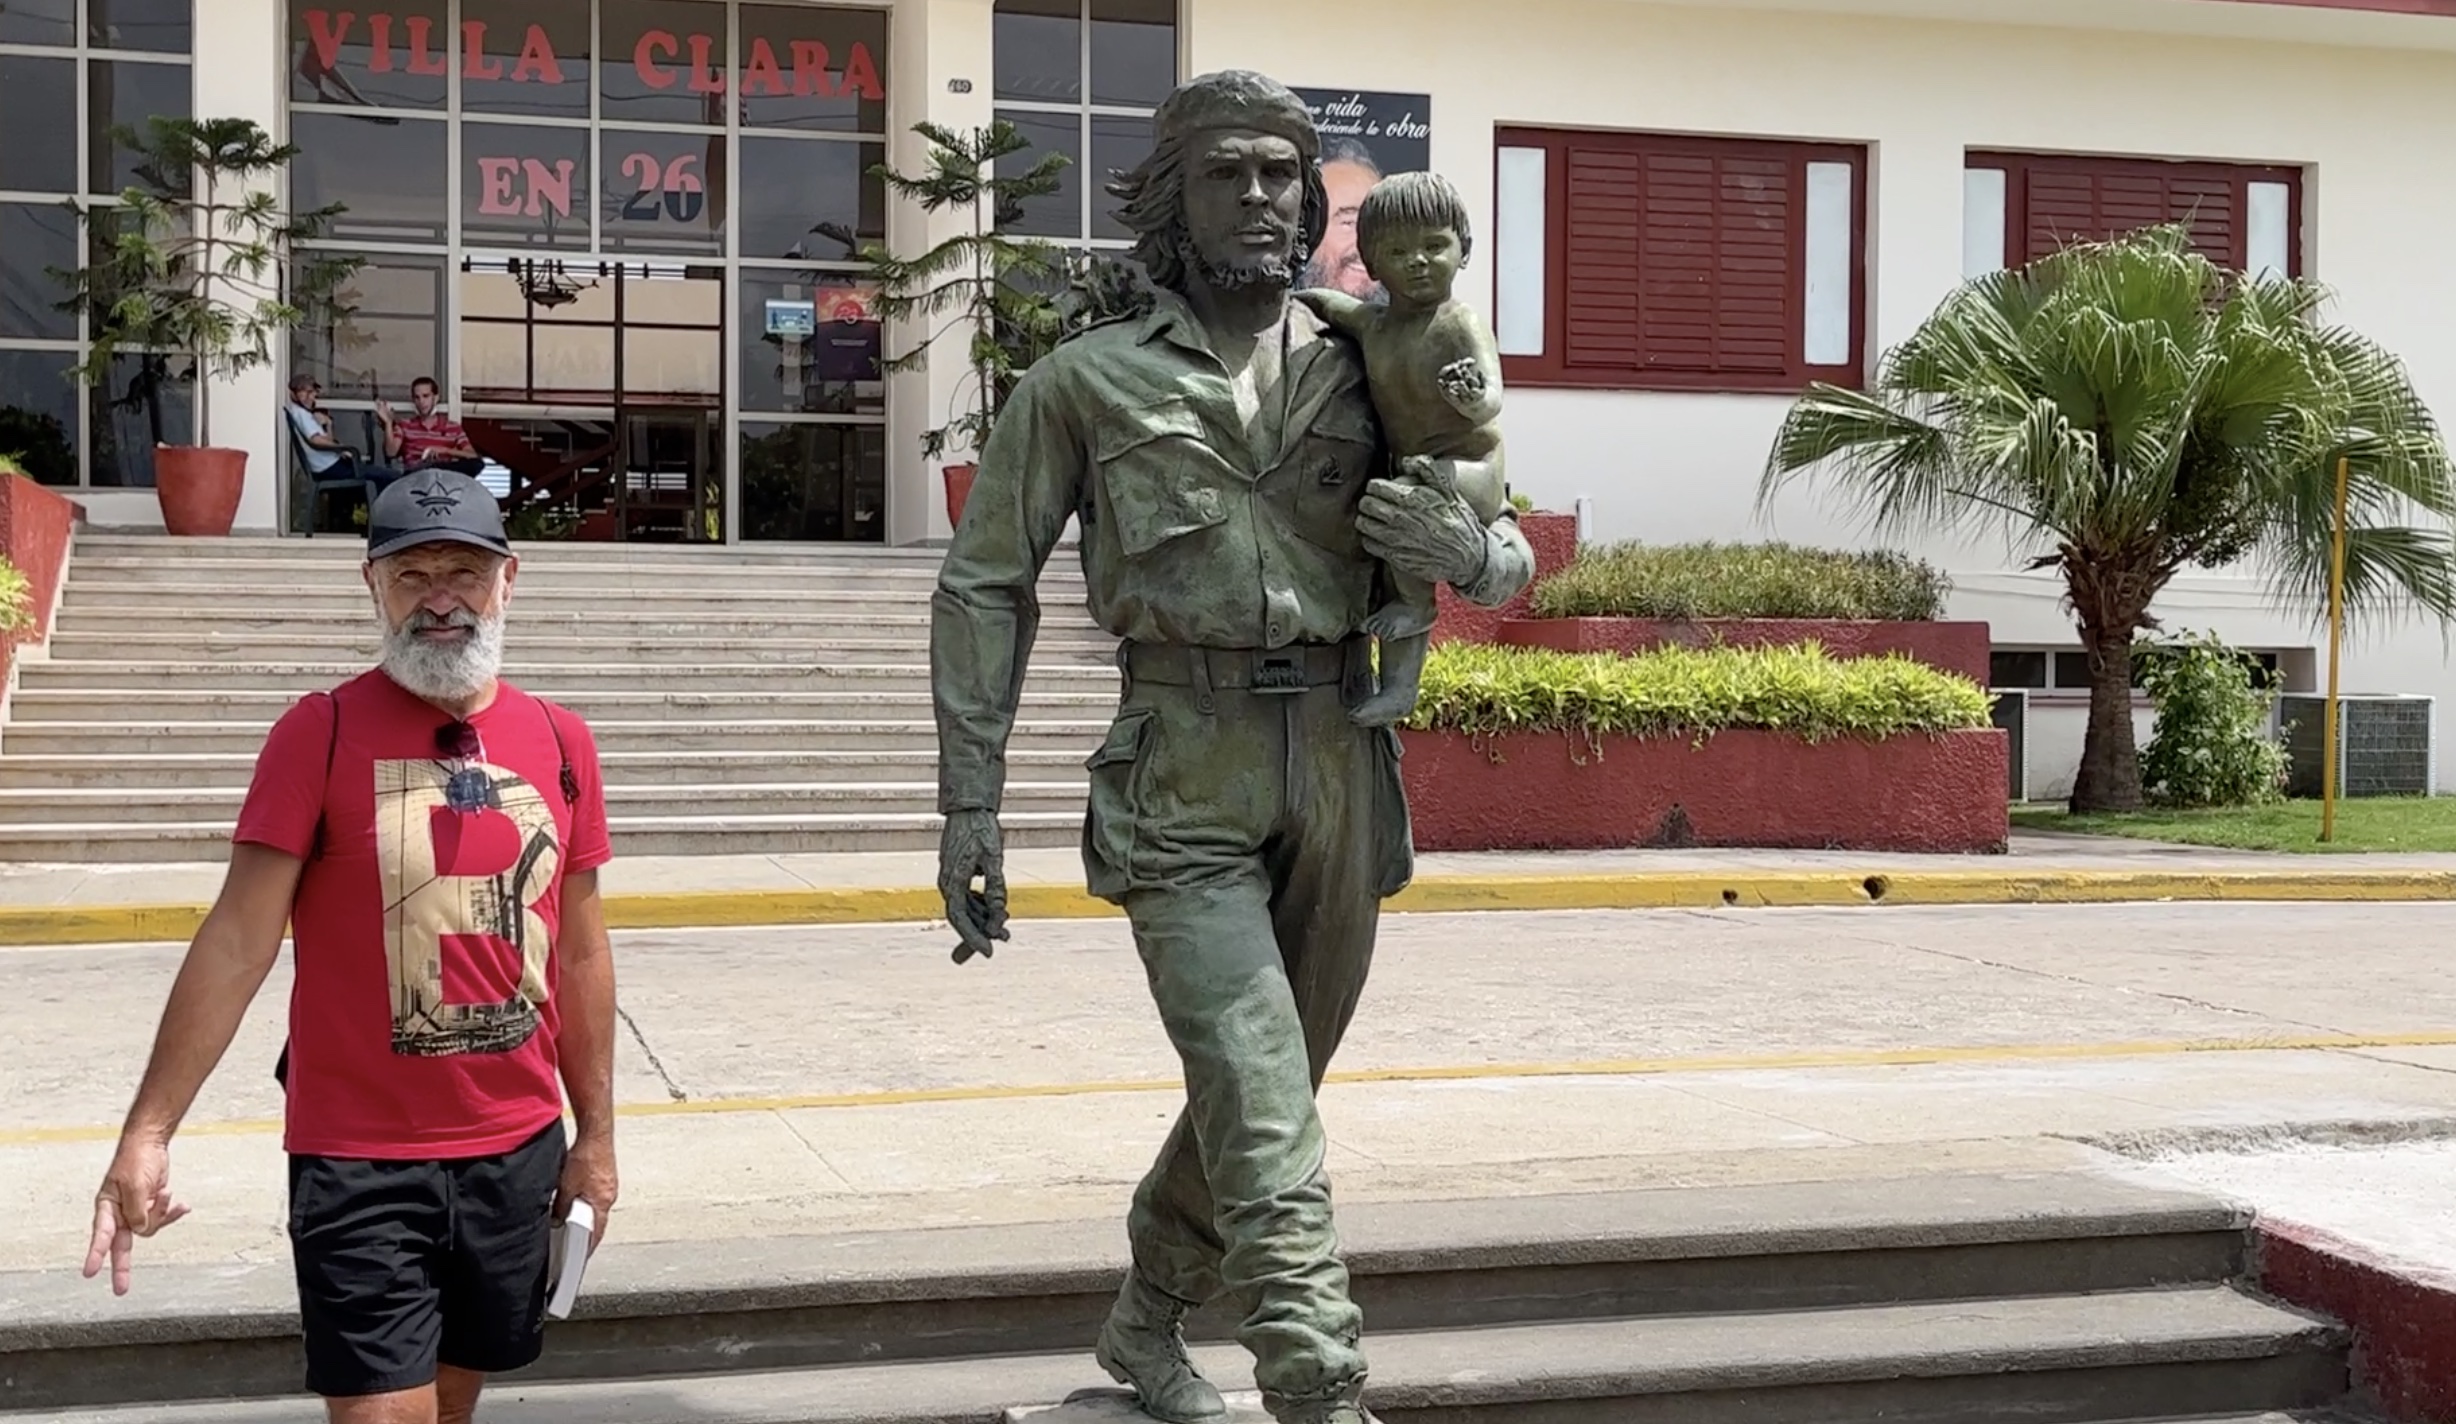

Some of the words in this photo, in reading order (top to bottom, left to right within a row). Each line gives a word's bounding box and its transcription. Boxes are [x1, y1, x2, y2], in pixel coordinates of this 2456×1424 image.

[303, 10, 564, 84] VILLA
[633, 29, 885, 99] CLARA
[1325, 94, 1368, 117] vida
[1366, 120, 1380, 136] la
[1386, 112, 1430, 139] obra
[478, 157, 574, 217] EN
[622, 153, 704, 222] 26
[373, 758, 560, 1056] B
